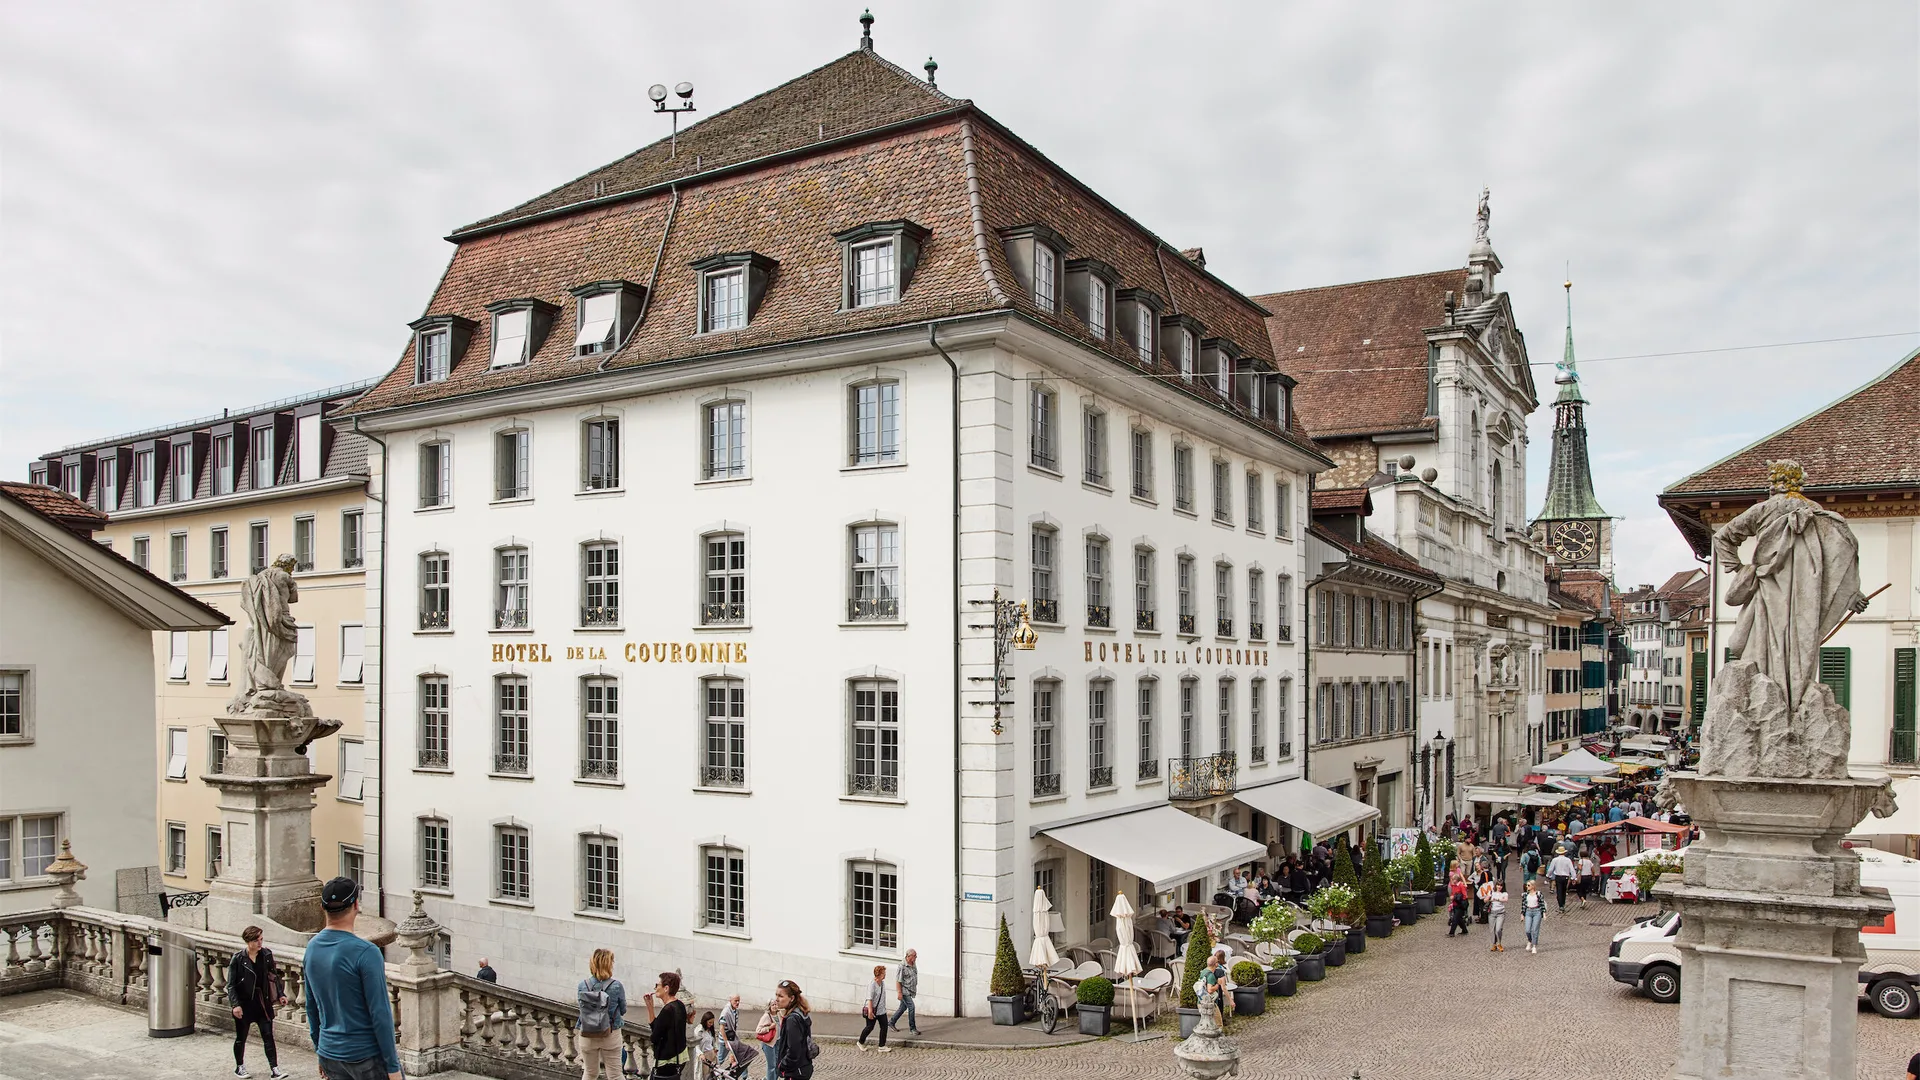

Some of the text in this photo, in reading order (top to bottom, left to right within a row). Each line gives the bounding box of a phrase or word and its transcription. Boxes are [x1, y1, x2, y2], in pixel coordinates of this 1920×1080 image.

[491, 642, 747, 664] HOTEL DE LA COURONNE
[1084, 641, 1268, 667] HOTEL DE LA COURONNE
